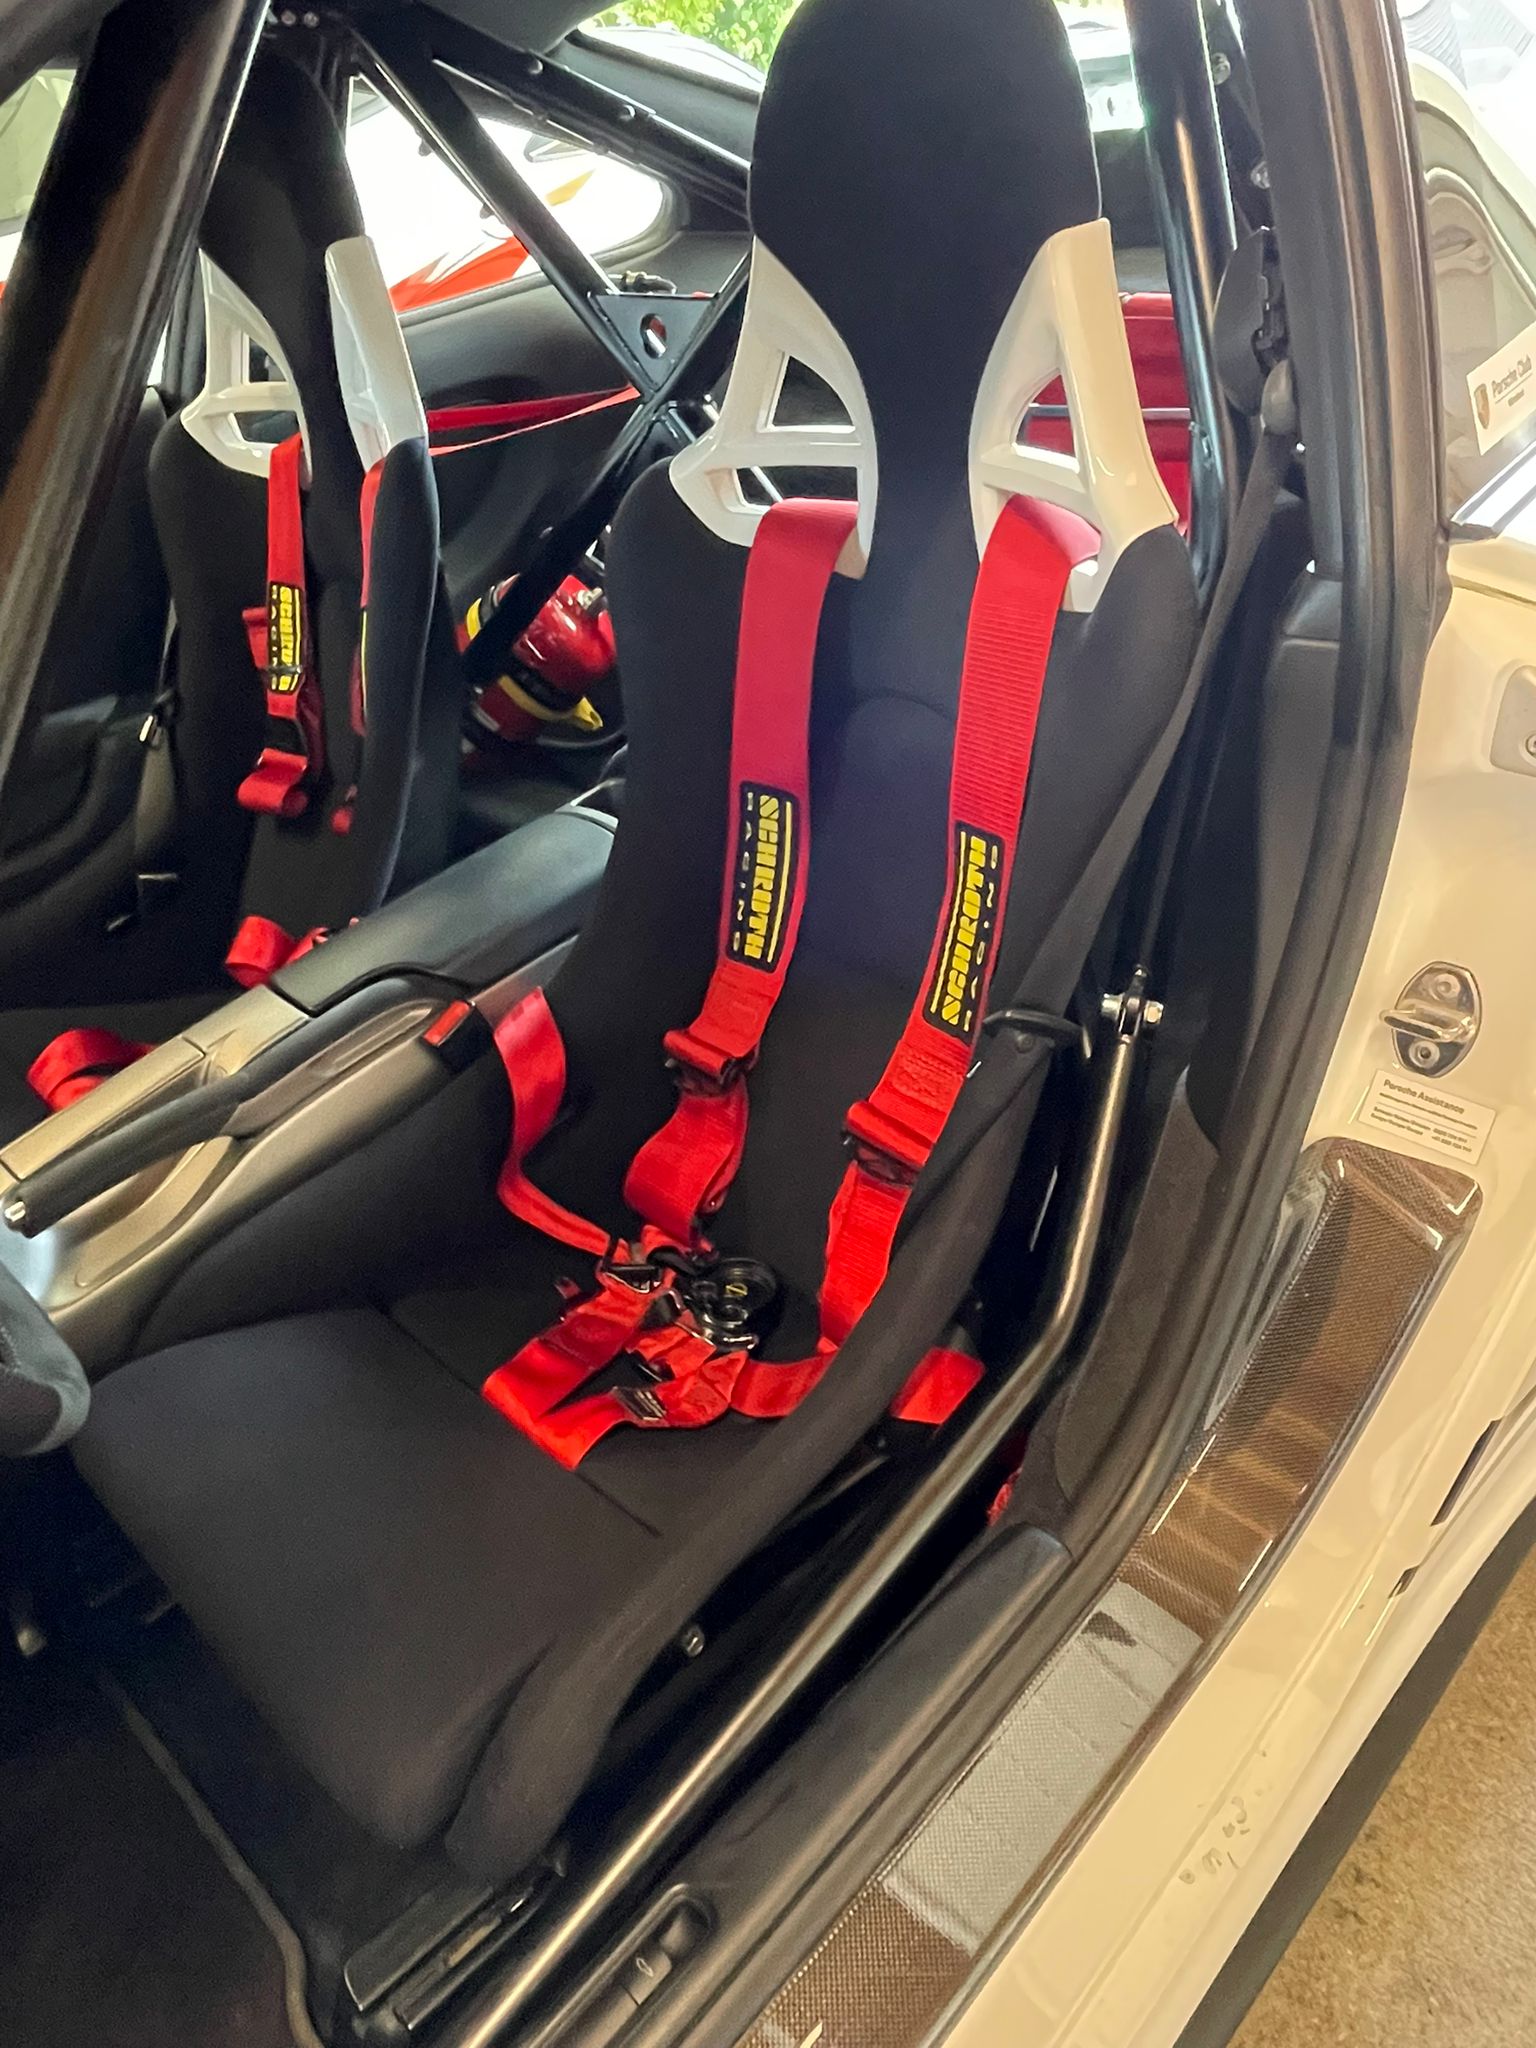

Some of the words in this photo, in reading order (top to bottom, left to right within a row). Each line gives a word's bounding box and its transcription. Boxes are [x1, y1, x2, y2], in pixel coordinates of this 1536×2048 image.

[278, 586, 294, 691] SCHROH
[744, 795, 780, 960] SCHROTH
[941, 836, 987, 1027] SCHROTH
[1383, 1079, 1418, 1098] Porsche
[1417, 1091, 1465, 1115] Assistance
